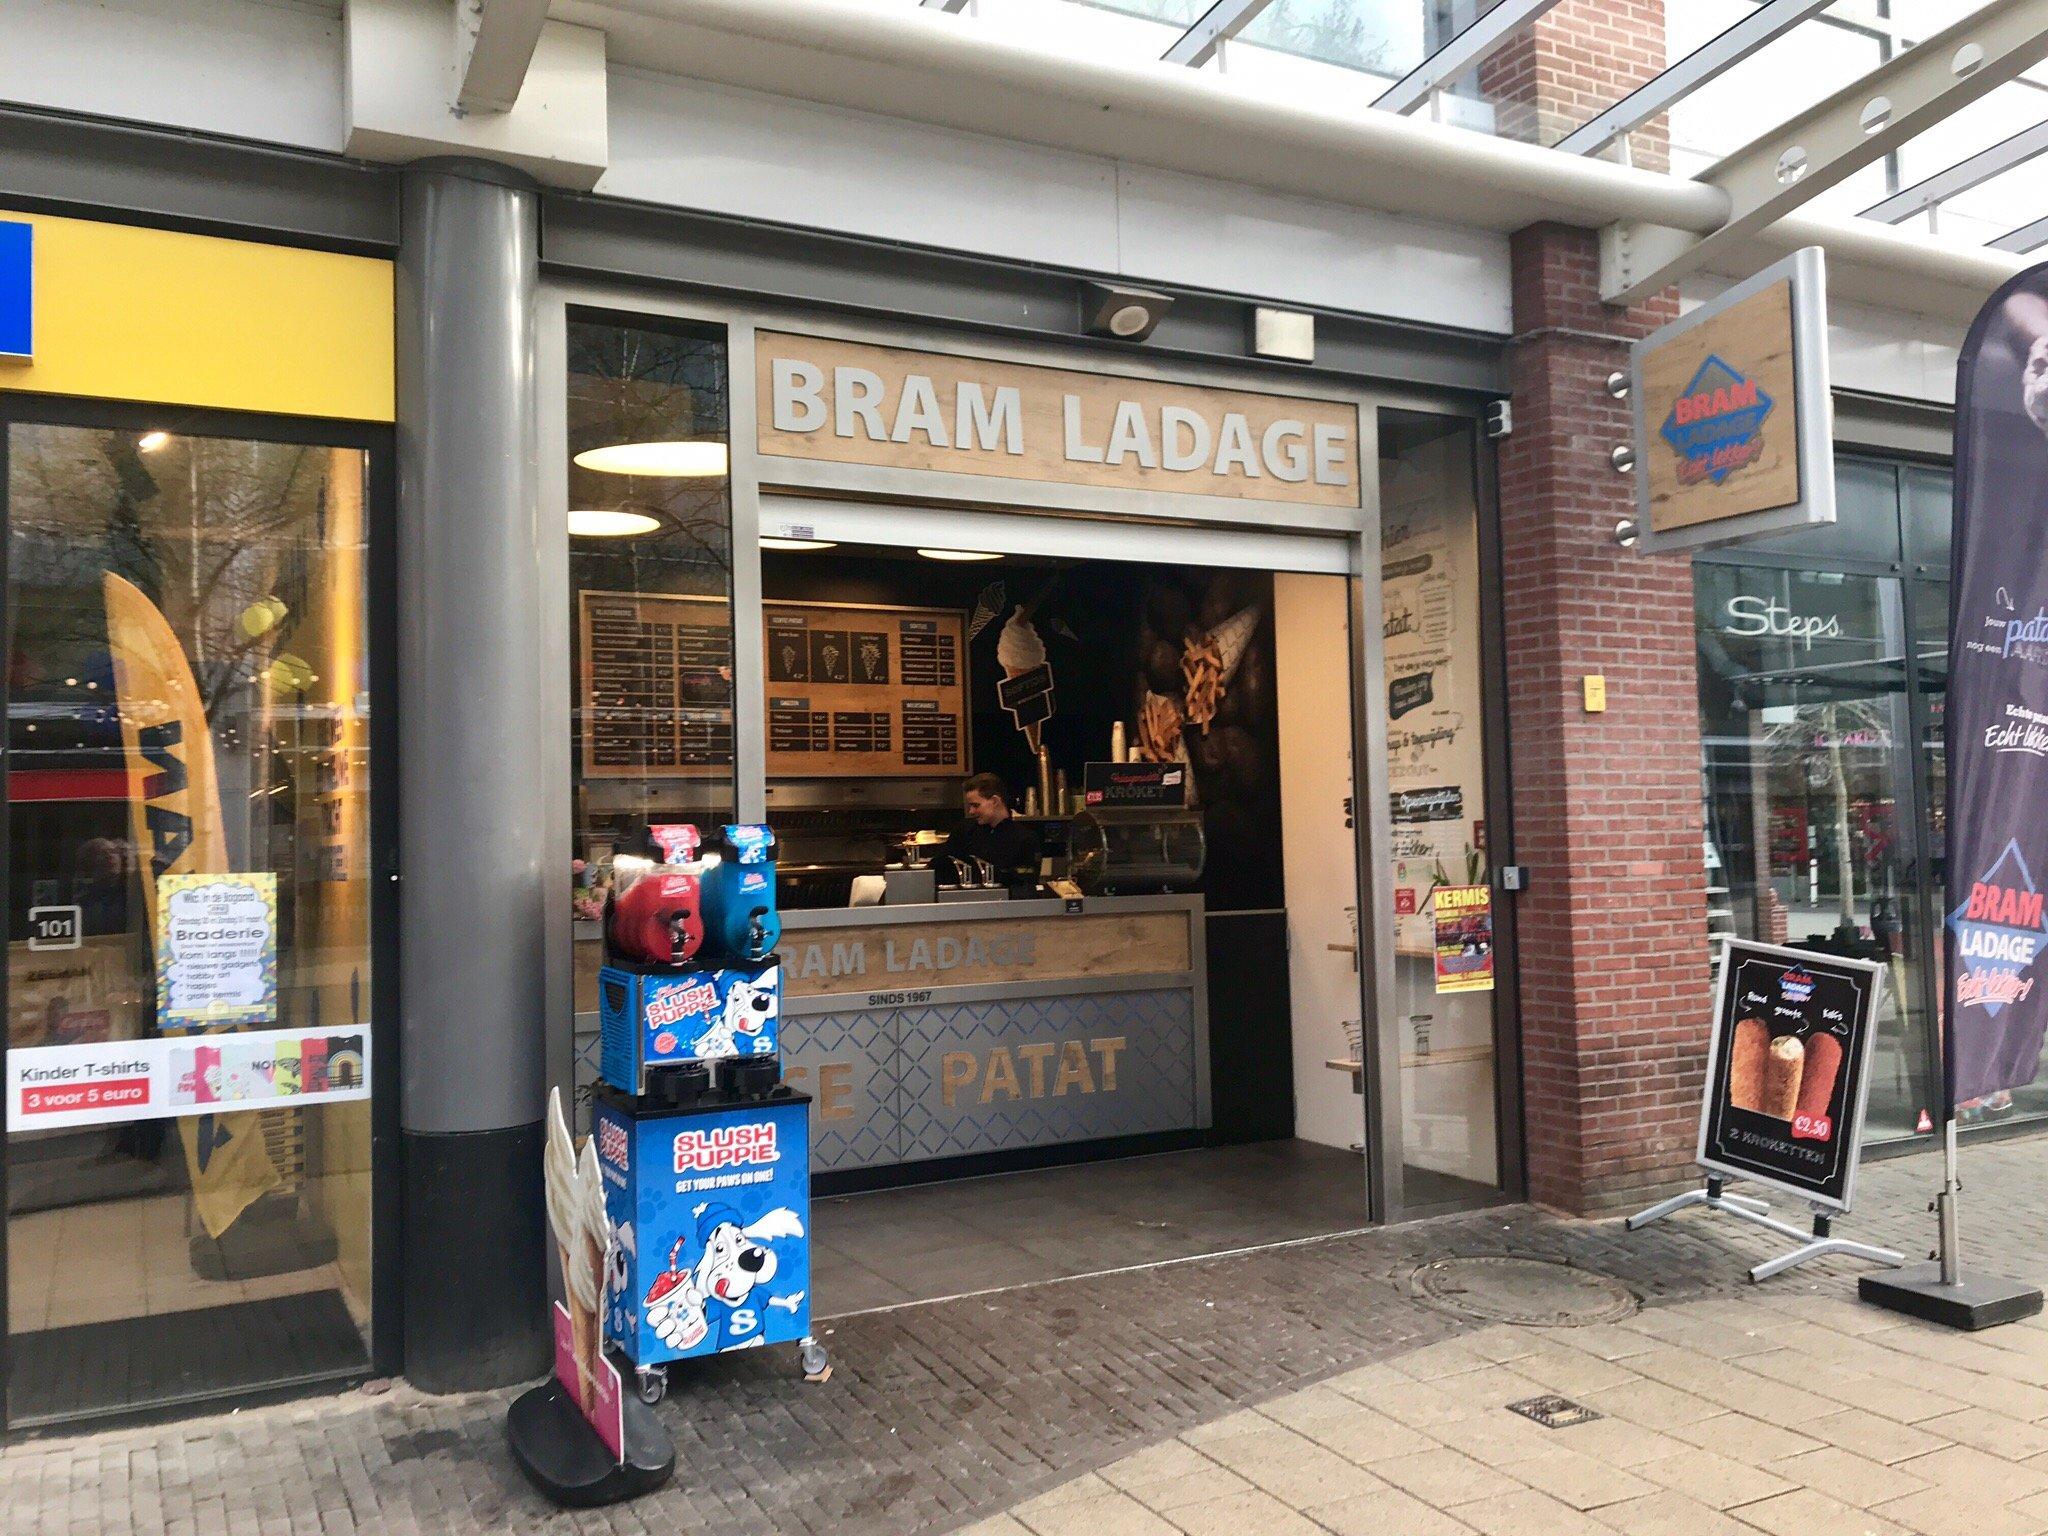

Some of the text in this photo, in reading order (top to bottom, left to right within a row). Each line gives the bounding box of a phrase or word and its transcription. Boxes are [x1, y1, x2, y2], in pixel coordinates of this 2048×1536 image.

[1676, 379, 1757, 425] BRAM
[771, 357, 1350, 485] BRAM LADAGE
[1726, 595, 1838, 651] Steps
[1434, 887, 1490, 909] KERMIS
[1967, 881, 2044, 929] BRAM
[38, 919, 73, 938] 101
[176, 928, 264, 940] Braderie
[180, 951, 204, 959] Kom
[886, 932, 1036, 973] LADAGE
[1959, 928, 2036, 966] LADAGE
[647, 984, 714, 1016] SLUSH
[868, 990, 932, 1006] SINDS 1967
[20, 1061, 151, 1082] Kinder T-shirts
[941, 1036, 1127, 1107] PATAT
[28, 1088, 143, 1108] 3 voor 5 euro
[676, 1125, 775, 1153] SLUSH
[1741, 1130, 1826, 1165] KROKETTEN
[676, 1168, 774, 1194] GET YOUR PAWS ON ONE!
[729, 1309, 758, 1336] S
